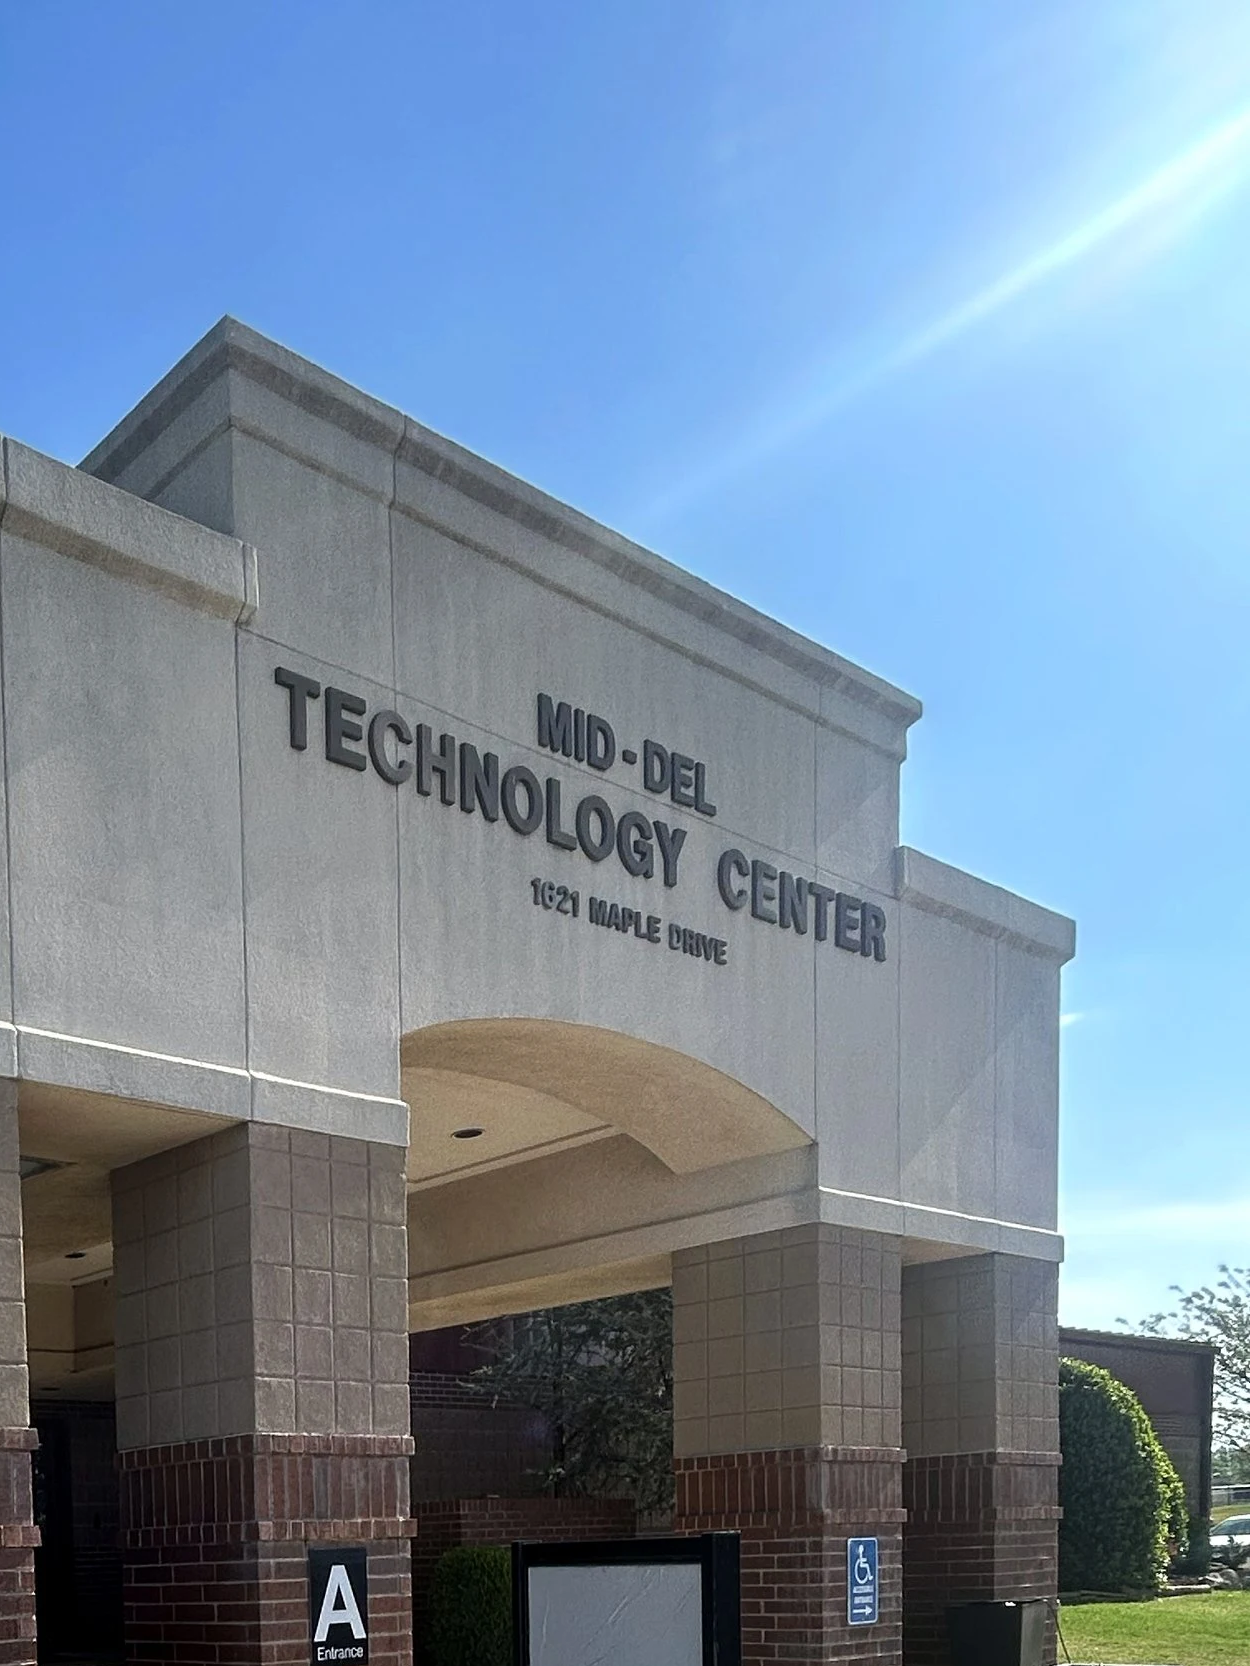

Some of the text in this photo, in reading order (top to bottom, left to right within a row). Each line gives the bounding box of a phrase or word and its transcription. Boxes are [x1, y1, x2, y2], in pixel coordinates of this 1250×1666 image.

[274, 666, 887, 962] TECHNOLOGY CENTER
[530, 877, 728, 966] 1621 MAPLE DRIVE
[313, 1564, 367, 1642] A
[317, 1646, 364, 1661] Entrance
